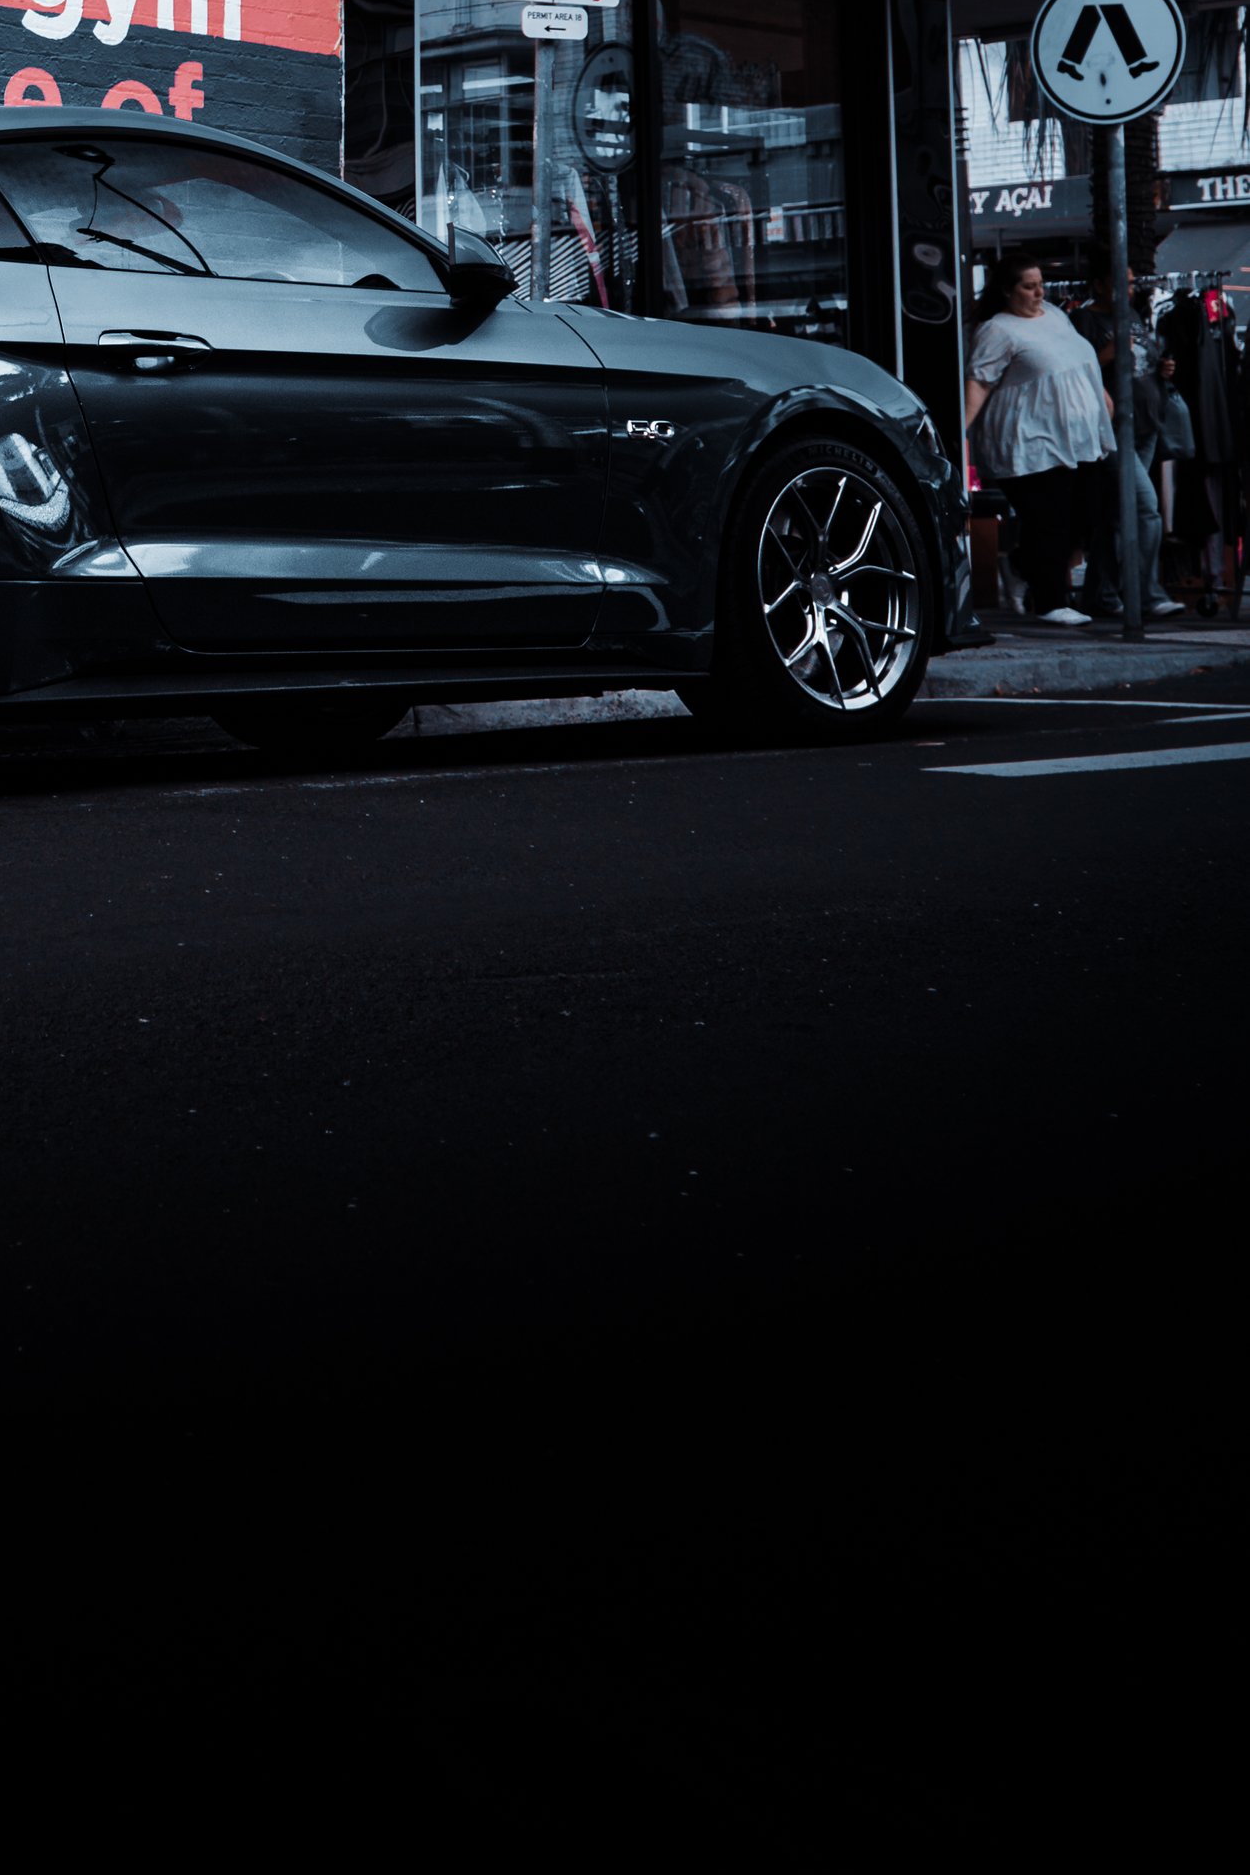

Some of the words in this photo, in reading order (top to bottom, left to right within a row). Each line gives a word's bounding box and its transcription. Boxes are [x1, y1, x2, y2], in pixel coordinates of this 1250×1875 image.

[527, 11, 553, 21] PERMIT
[554, 12, 573, 21] AREA
[808, 444, 874, 472] MICHELIN
